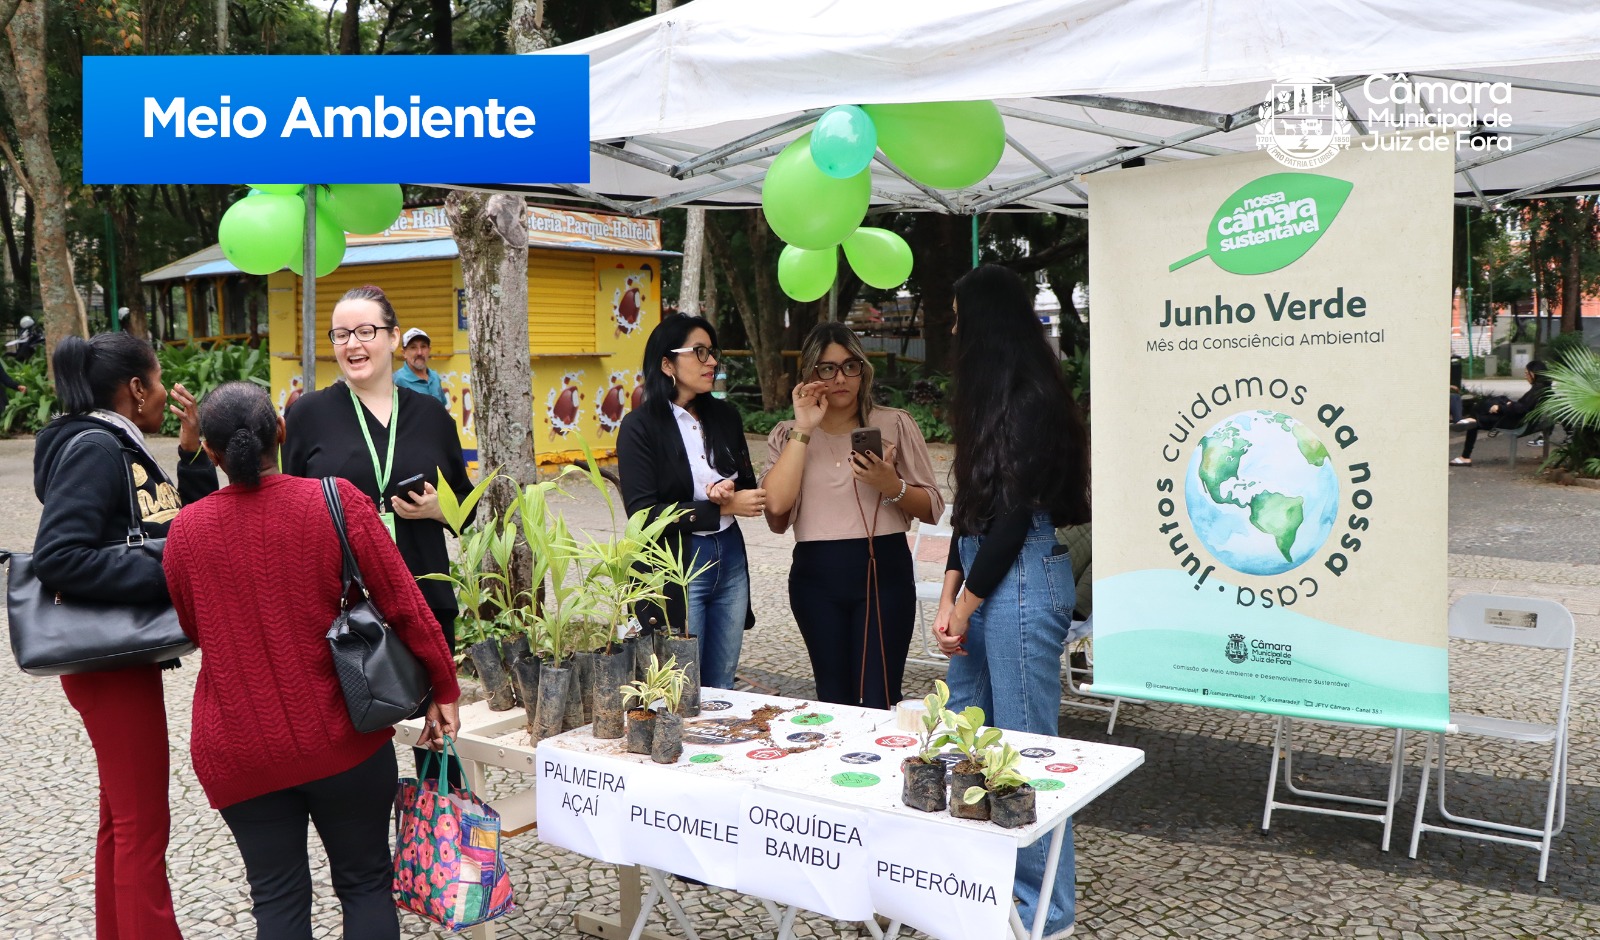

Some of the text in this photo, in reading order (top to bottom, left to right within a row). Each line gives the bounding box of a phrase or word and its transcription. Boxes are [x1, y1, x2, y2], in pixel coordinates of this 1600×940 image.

[1243, 191, 1286, 211] nossa
[411, 207, 451, 229] Half
[565, 215, 612, 241] Parque
[612, 220, 654, 241] Halfeld
[1217, 197, 1318, 236] câmara
[1220, 215, 1320, 252] sustentável
[1159, 286, 1367, 328] Junho Verde
[1146, 329, 1385, 353] Mês da Consciência Ambiental
[1156, 376, 1373, 609] juntos cuidamos da nossa casa
[1251, 639, 1292, 651] Câmara
[1251, 649, 1283, 658] Municipal
[1250, 655, 1265, 663] Juiz
[1275, 657, 1292, 666] Fora
[1173, 664, 1200, 672] Comissão
[1225, 670, 1253, 678] Ambiente
[1261, 673, 1313, 683] Desenvolvimento
[1314, 679, 1350, 688] Sustentável
[544, 761, 625, 793] PALMEIRA
[562, 792, 600, 817] AÇAÍ
[631, 805, 739, 845] PLEOMELE
[749, 805, 863, 847] ORQUÍDEA
[765, 837, 841, 870] BAMBU
[877, 860, 998, 905] PEPERÔMIA
